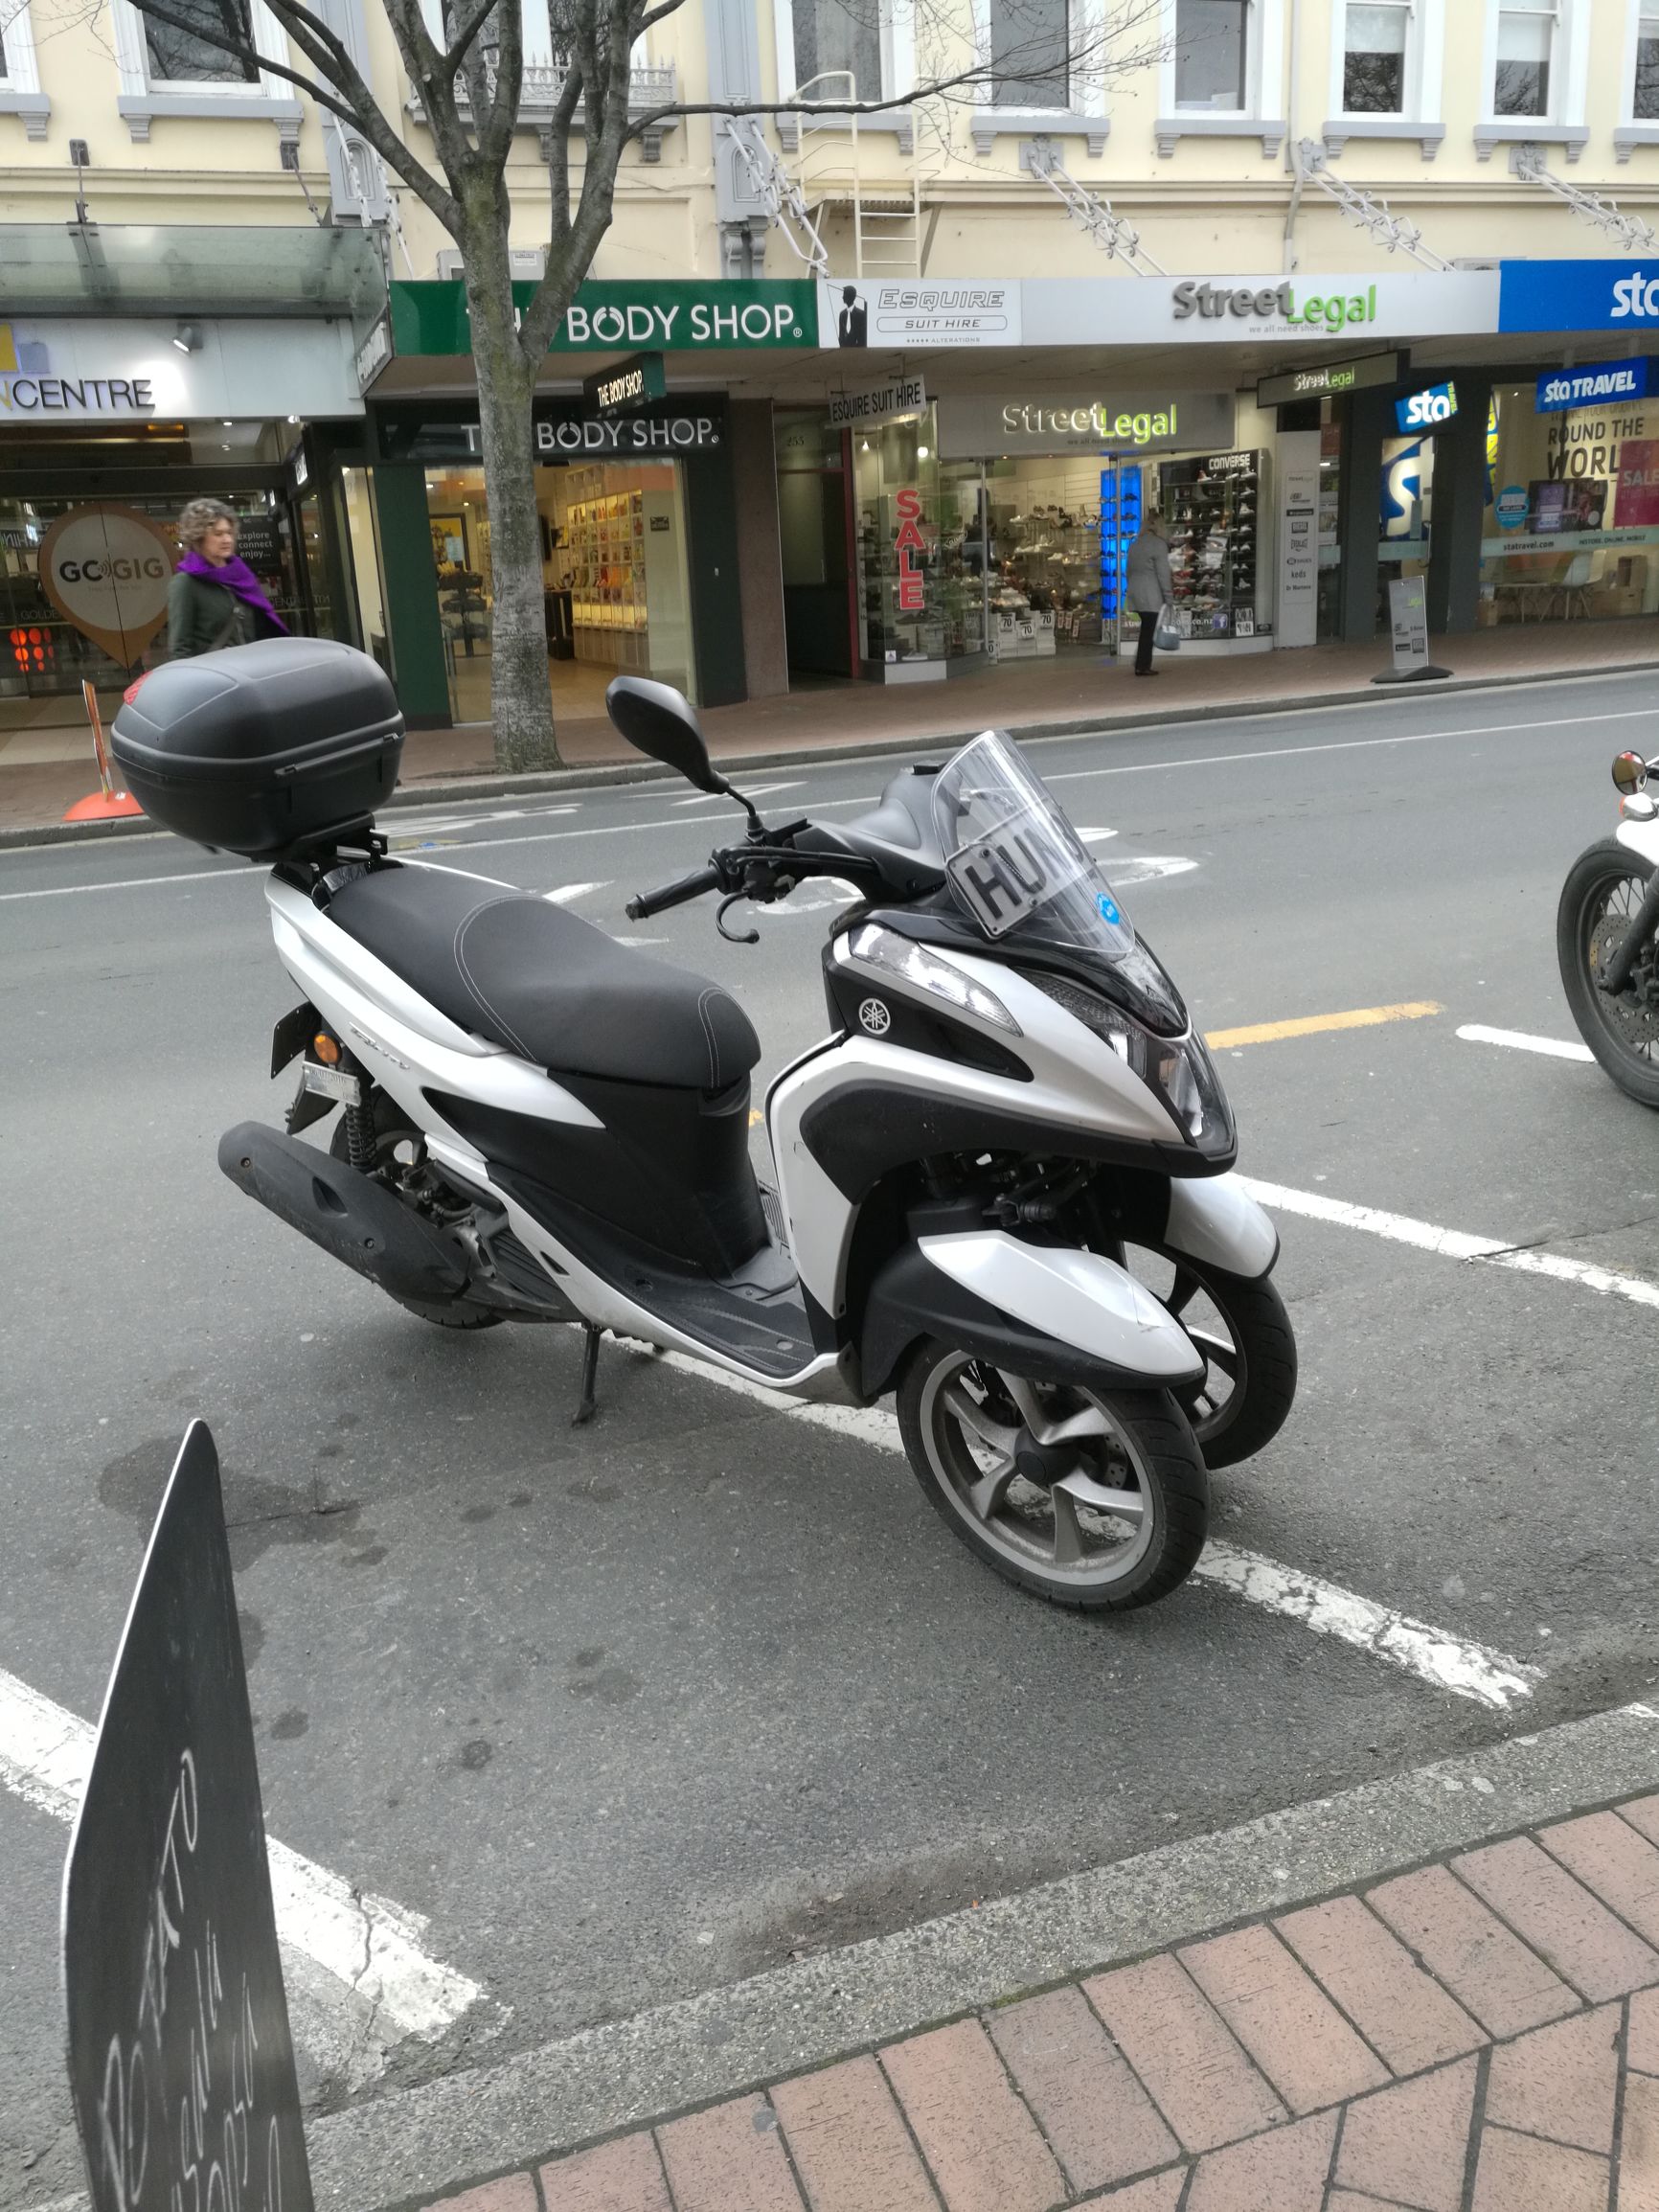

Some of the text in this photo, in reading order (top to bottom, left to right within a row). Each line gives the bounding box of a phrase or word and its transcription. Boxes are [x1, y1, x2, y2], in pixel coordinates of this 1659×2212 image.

[567, 305, 679, 342] BODY
[904, 318, 982, 330] SUIT HIRE
[1263, 324, 1274, 332] all
[1277, 324, 1298, 332] need
[597, 385, 609, 407] THE
[609, 376, 626, 402] BODY
[1572, 371, 1636, 398] TRAVEL
[831, 382, 921, 422] ESQUIRE SUIT HIRE
[1406, 390, 1450, 423] sta
[537, 420, 624, 449] BODY
[1548, 417, 1644, 445] ROUND THE
[1209, 454, 1250, 470] CONVERSE
[1547, 445, 1619, 479] WORL
[239, 540, 273, 549] connect
[895, 490, 925, 610] SALE
[1502, 540, 1555, 552] statravel.com
[1002, 618, 1012, 627] 70
